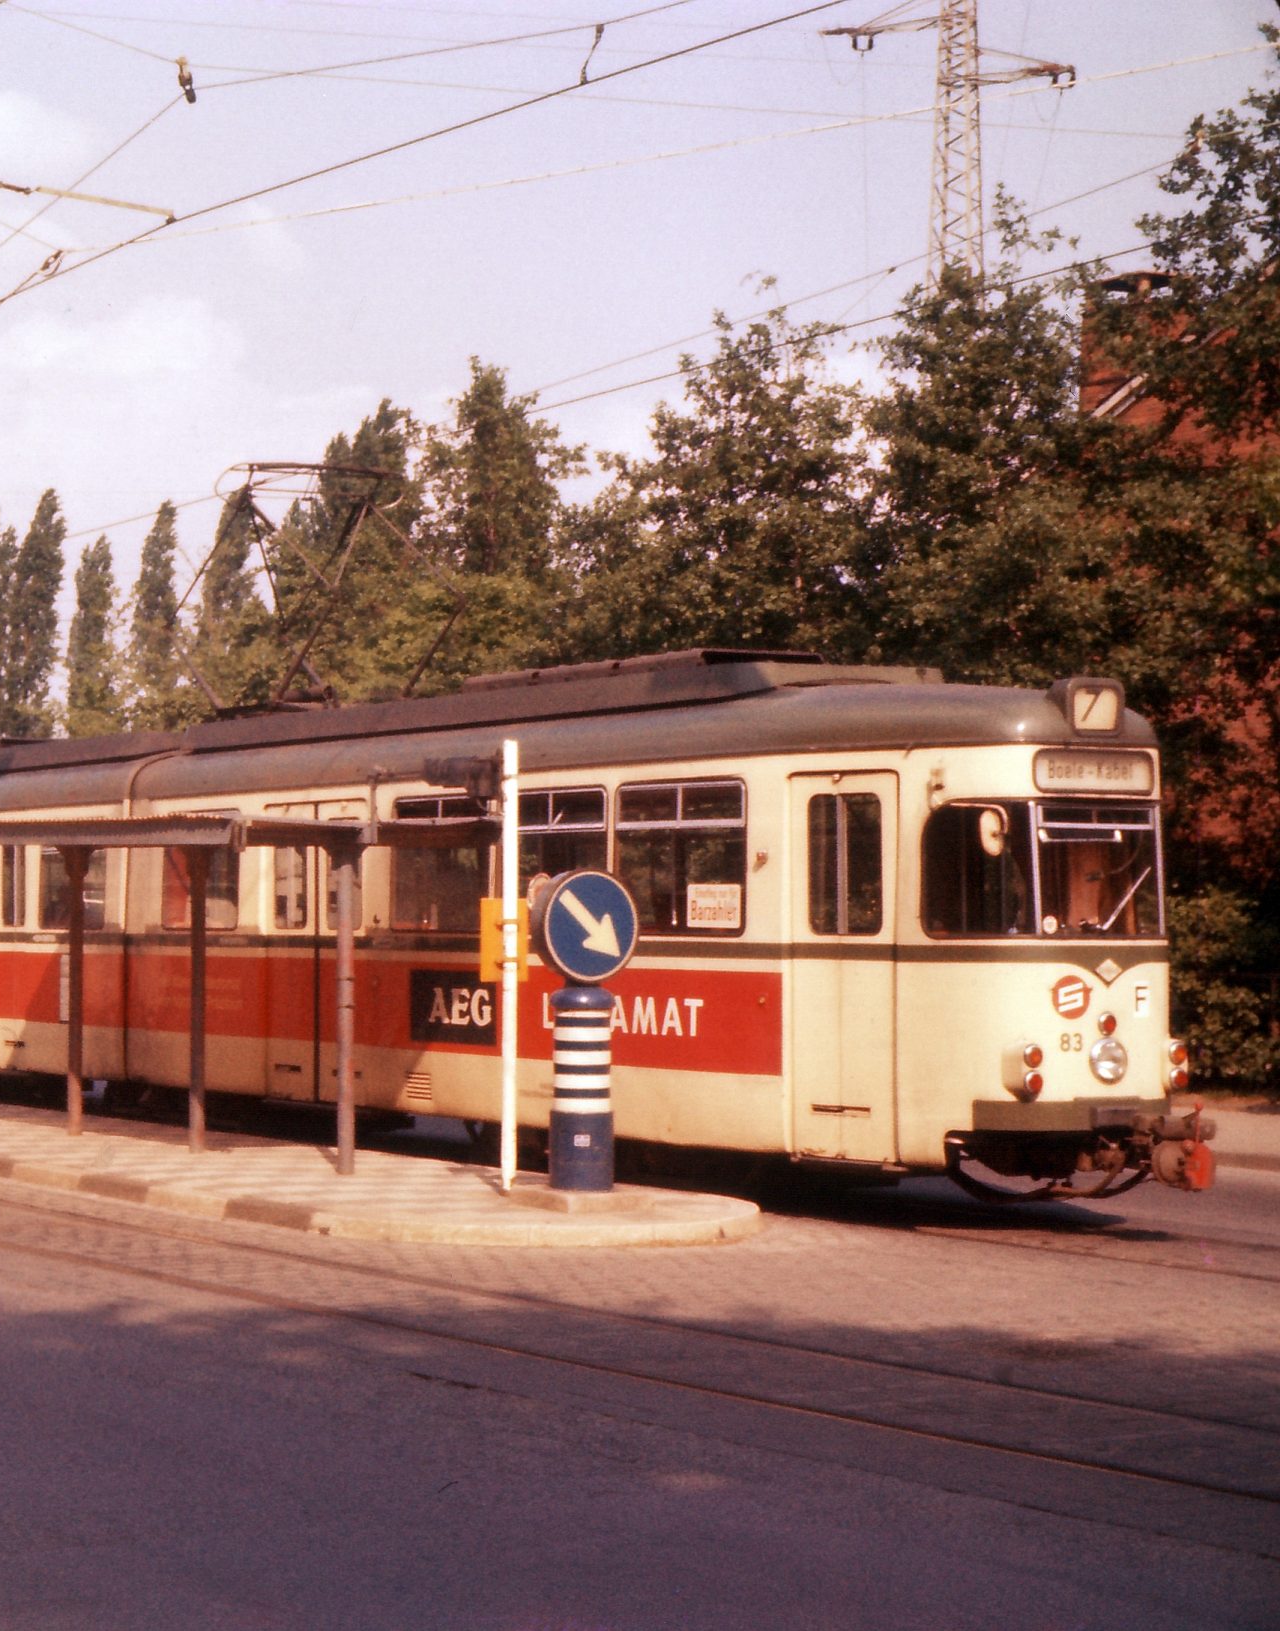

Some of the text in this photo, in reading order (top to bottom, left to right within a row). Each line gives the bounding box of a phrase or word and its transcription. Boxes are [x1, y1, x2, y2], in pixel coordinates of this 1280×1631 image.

[1080, 685, 1105, 722] 7
[429, 987, 705, 1036] AEG LAMAT
[1135, 985, 1149, 1012] F
[1059, 1033, 1083, 1052] 83
